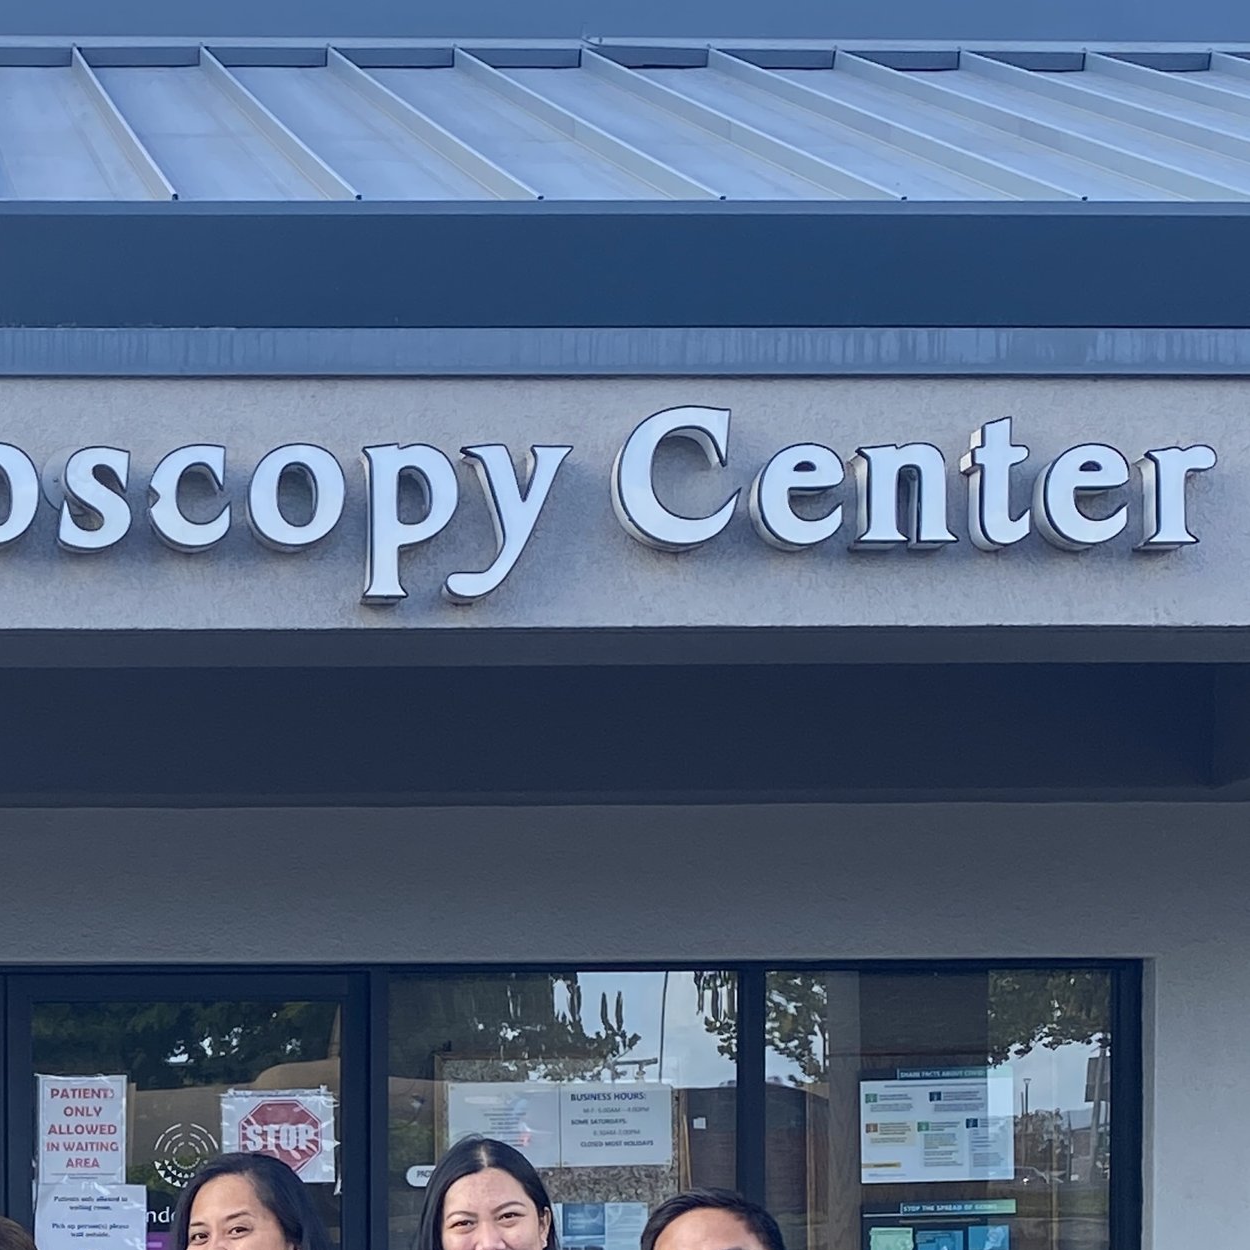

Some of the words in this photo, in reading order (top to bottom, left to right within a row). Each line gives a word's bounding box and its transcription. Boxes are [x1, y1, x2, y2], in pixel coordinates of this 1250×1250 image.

[610, 405, 1218, 553] Center
[570, 1093, 611, 1101] BUSINESS
[63, 1106, 102, 1117] ONLY
[48, 1124, 117, 1135] ALLOWED
[246, 1123, 315, 1151] STOP
[46, 1142, 60, 1152] IN
[63, 1142, 119, 1152] WAITING
[66, 1157, 100, 1168] AREA
